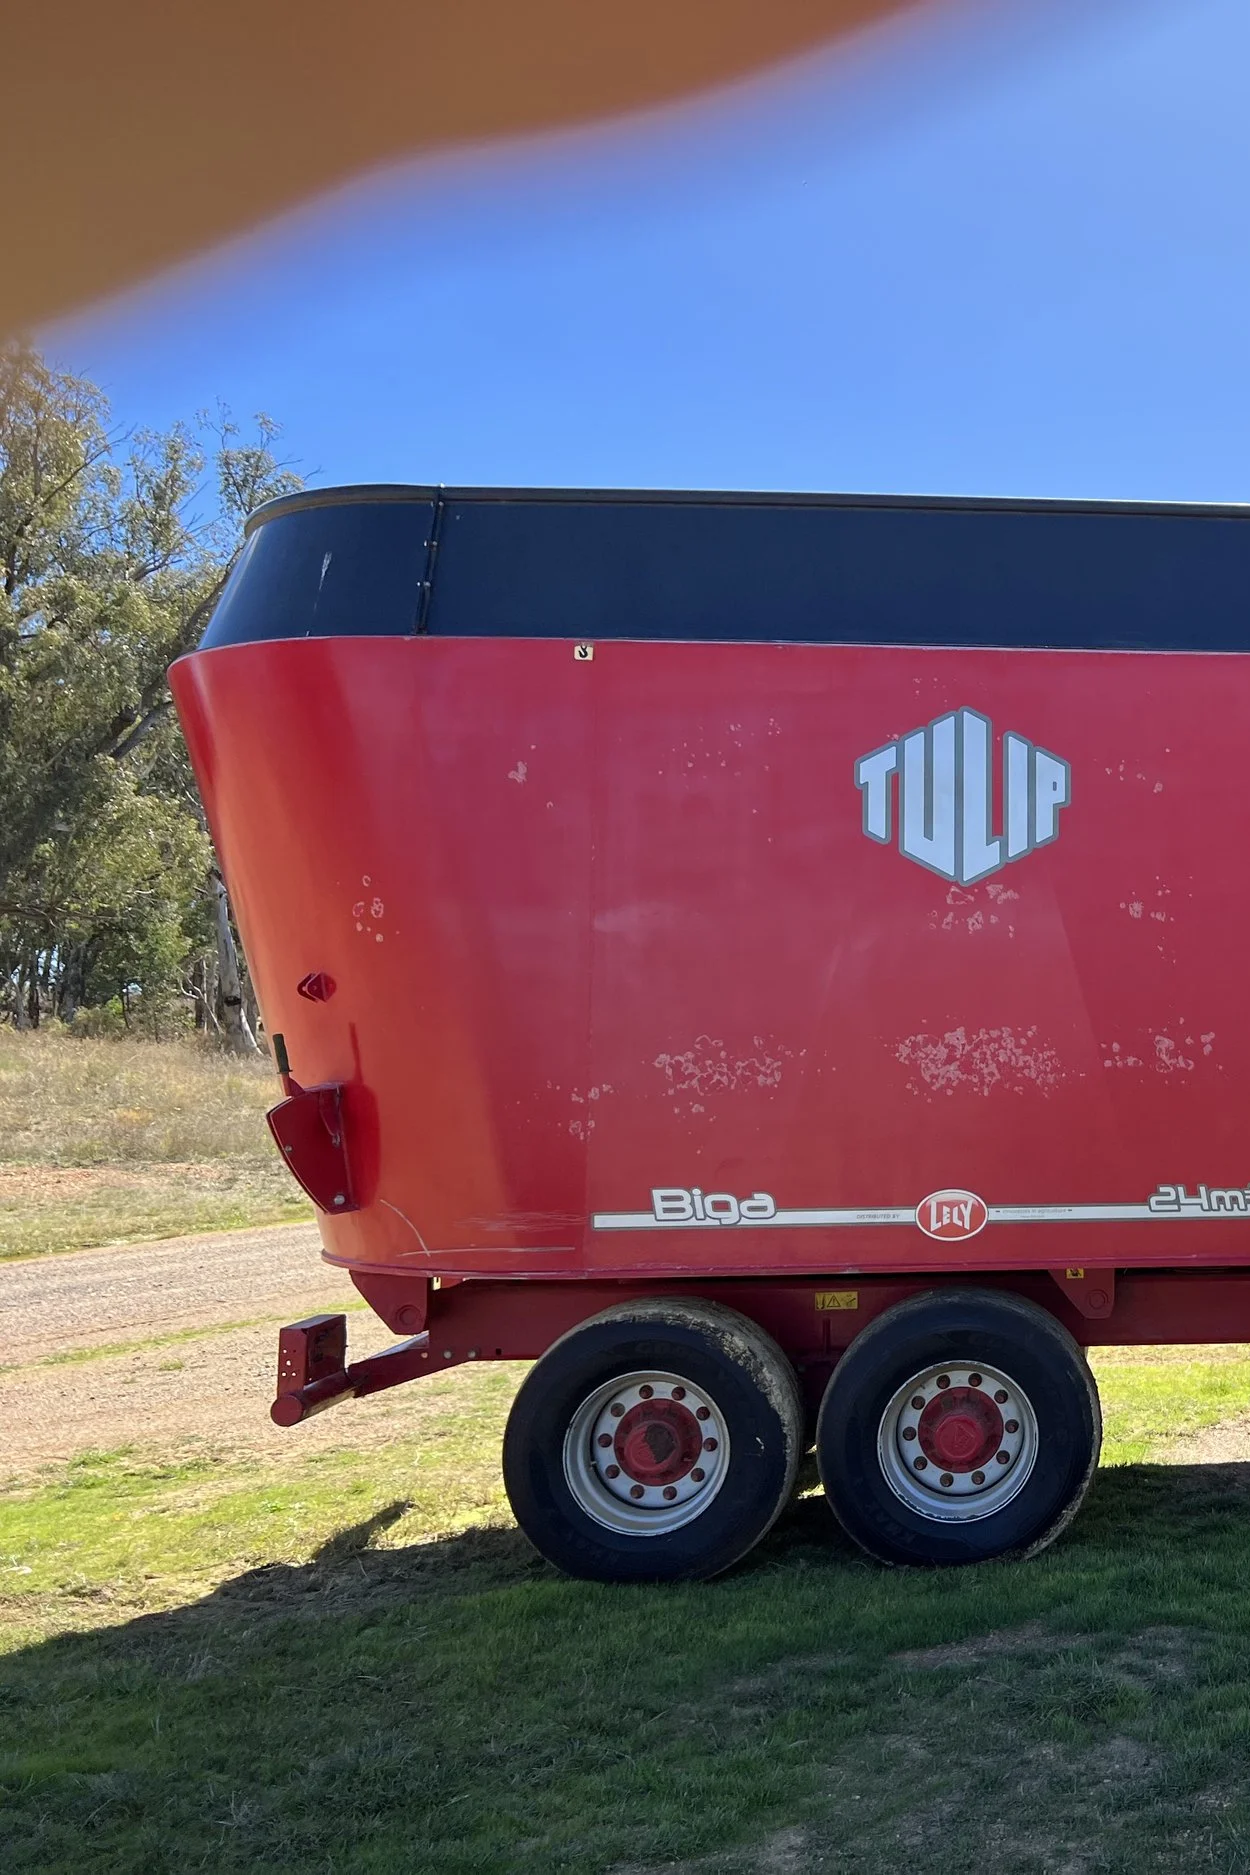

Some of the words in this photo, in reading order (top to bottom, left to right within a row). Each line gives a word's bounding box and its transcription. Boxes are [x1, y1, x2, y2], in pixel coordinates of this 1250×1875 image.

[857, 709, 1068, 884] TULIP
[651, 1187, 777, 1226] Biga
[930, 1199, 974, 1232] LELY
